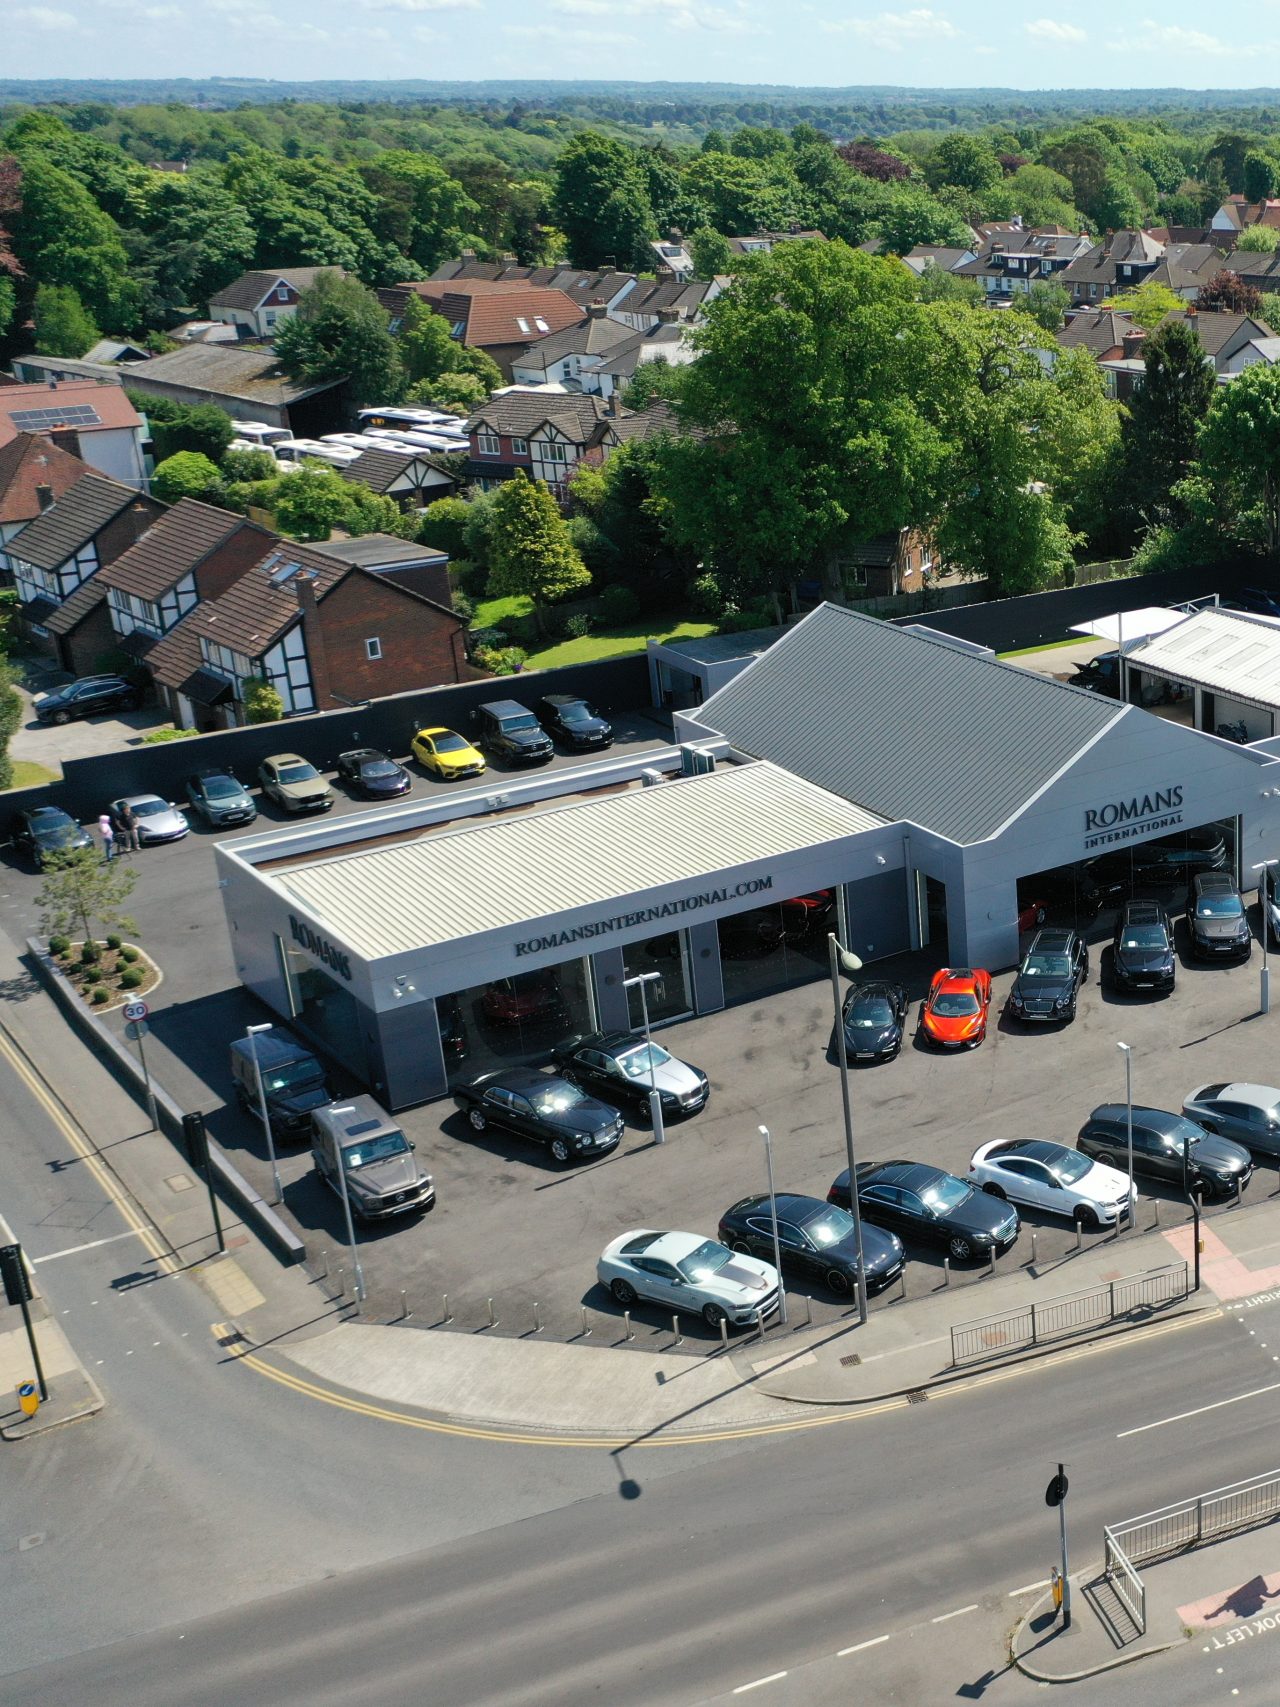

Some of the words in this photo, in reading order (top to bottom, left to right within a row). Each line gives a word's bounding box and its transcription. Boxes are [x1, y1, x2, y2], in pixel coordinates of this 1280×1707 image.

[1084, 785, 1184, 832] ROMANS
[1084, 814, 1184, 849] INTERNATIONAL
[514, 875, 773, 957] ROMANSINTERNATIONAL.COM
[288, 913, 352, 982] ROMANS
[127, 1006, 145, 1017] 30
[1212, 1625, 1254, 1650] LEFT
